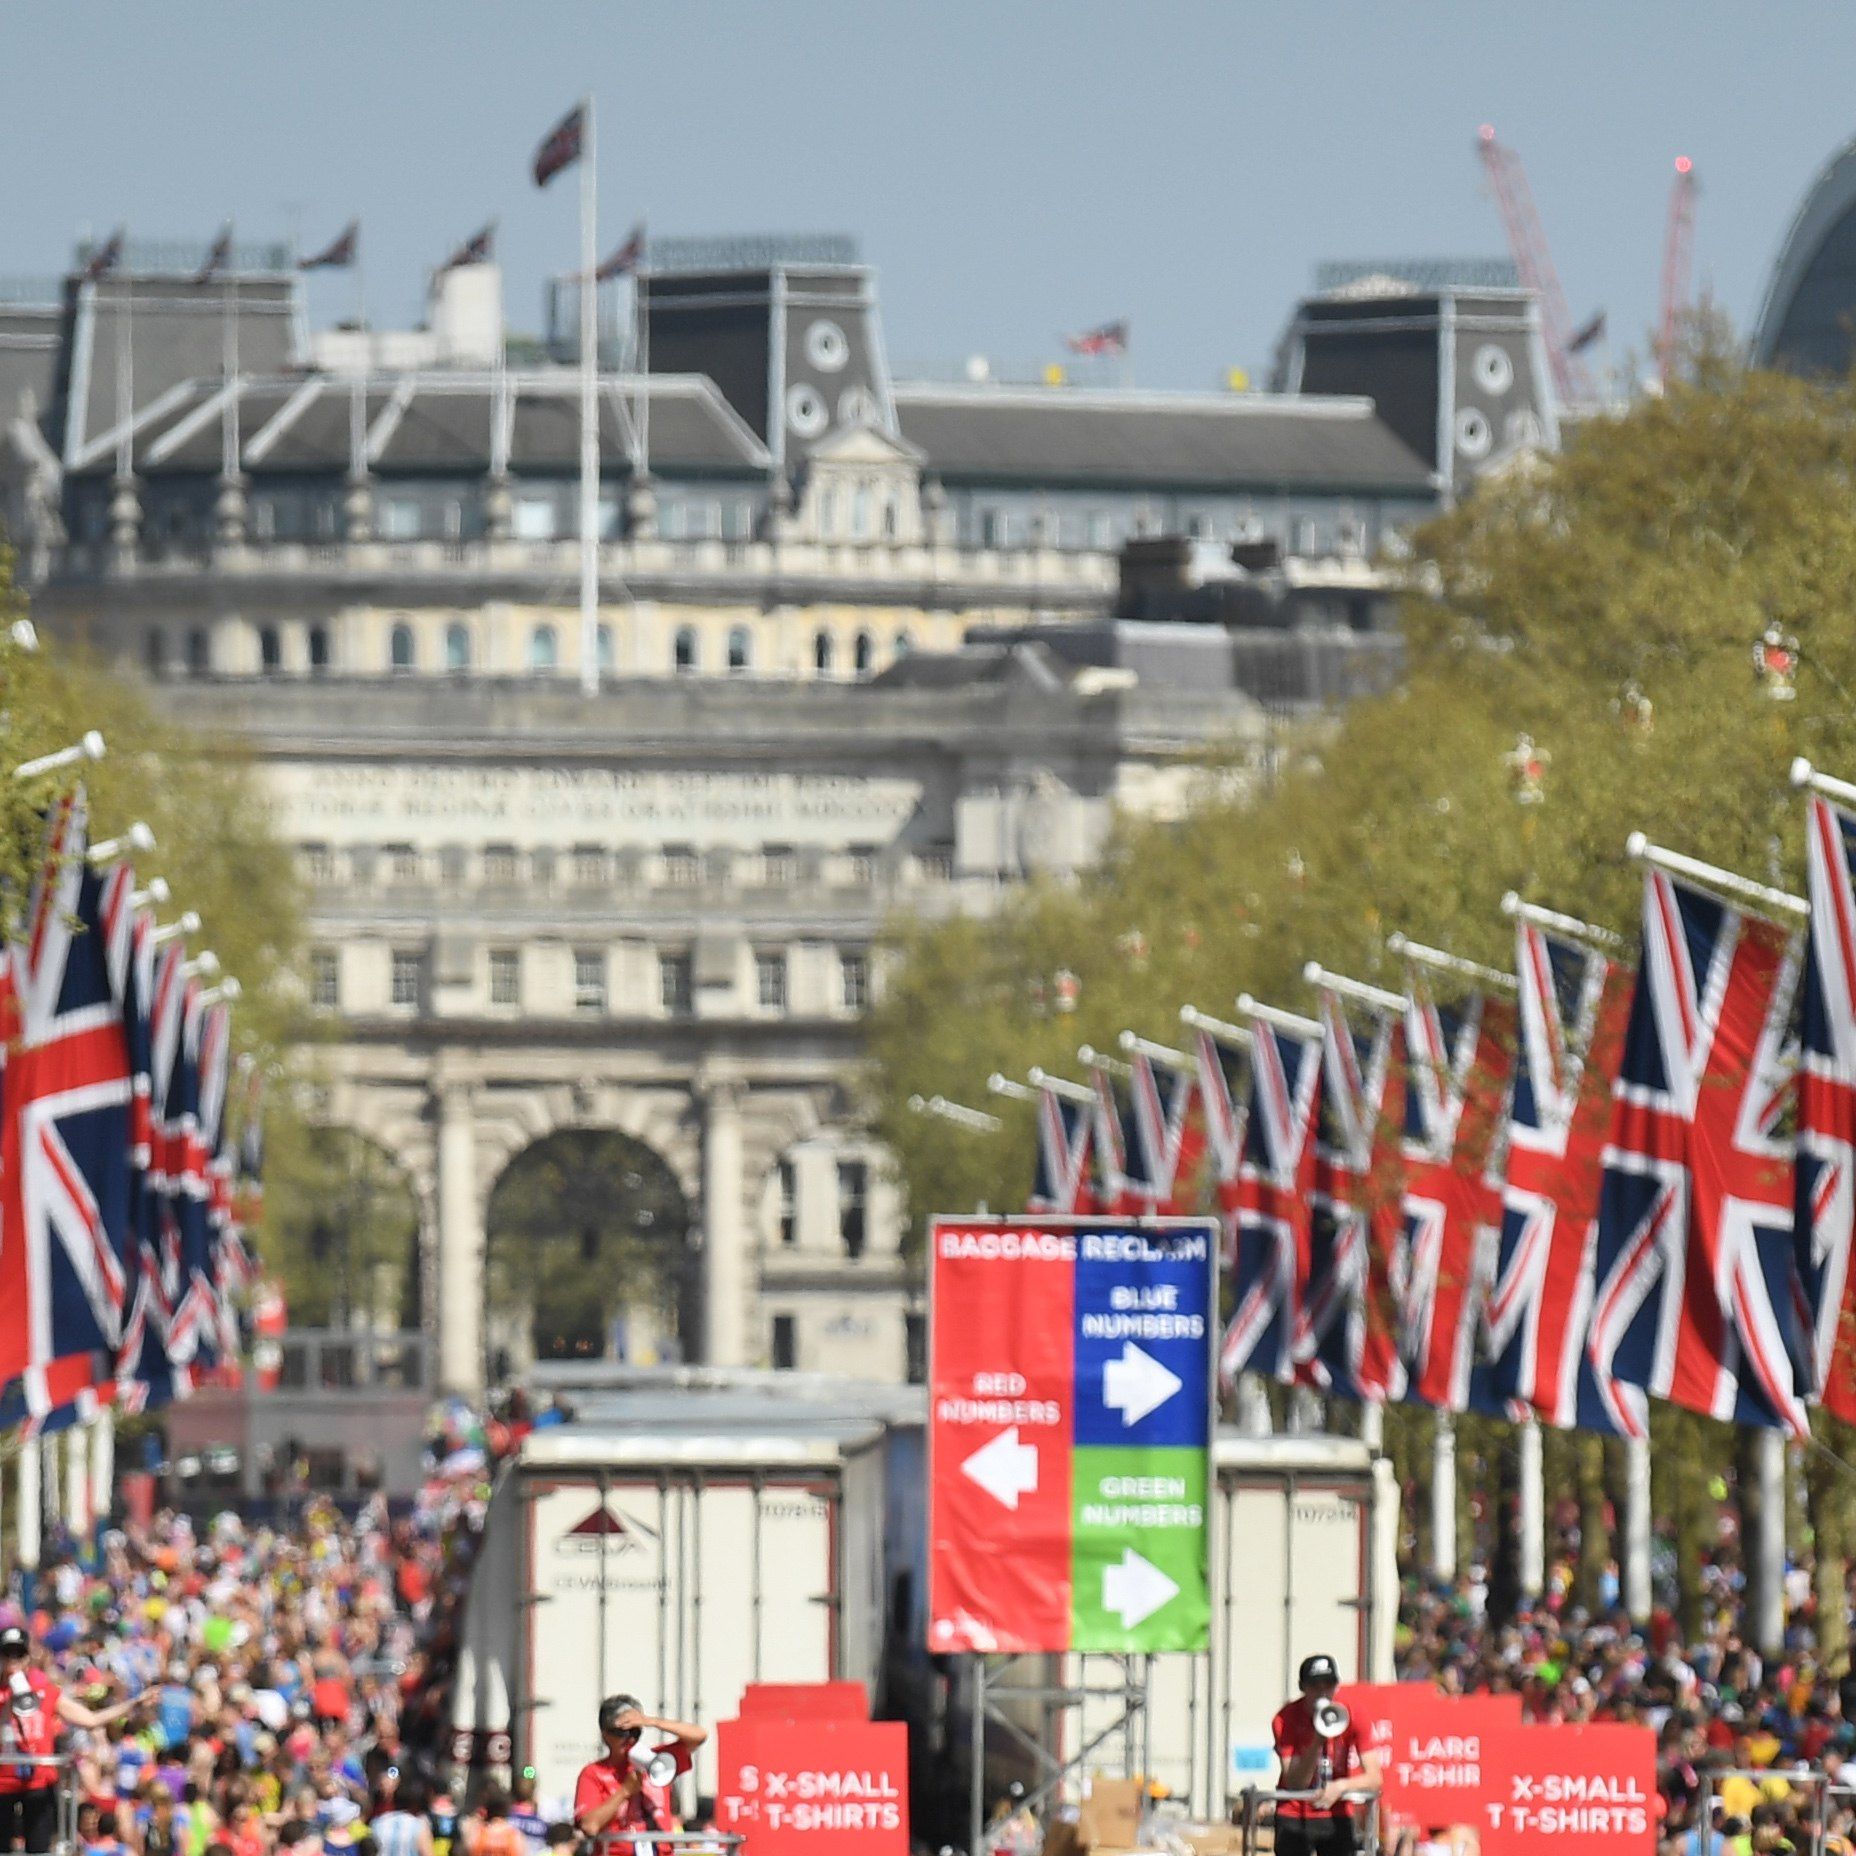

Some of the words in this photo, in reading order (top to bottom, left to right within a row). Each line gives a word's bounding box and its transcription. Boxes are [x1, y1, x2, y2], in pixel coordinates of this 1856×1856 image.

[940, 1233, 1077, 1261] BAGGAGE
[1111, 1286, 1178, 1311] BLUE
[1082, 1313, 1204, 1341] NUMBERS
[973, 1372, 1027, 1397] RED
[938, 1400, 1062, 1425] NUMBERS
[1099, 1477, 1185, 1499] GREEN
[1080, 1503, 1203, 1528] NUMBERS
[1410, 1736, 1480, 1762] LARG
[764, 1770, 901, 1799] X-SMALL
[1398, 1763, 1481, 1788] T-SHIR
[1513, 1776, 1646, 1803] X-SMALL
[765, 1803, 901, 1831] T-SHIRTS
[1514, 1806, 1647, 1835] T-SHIRTS
